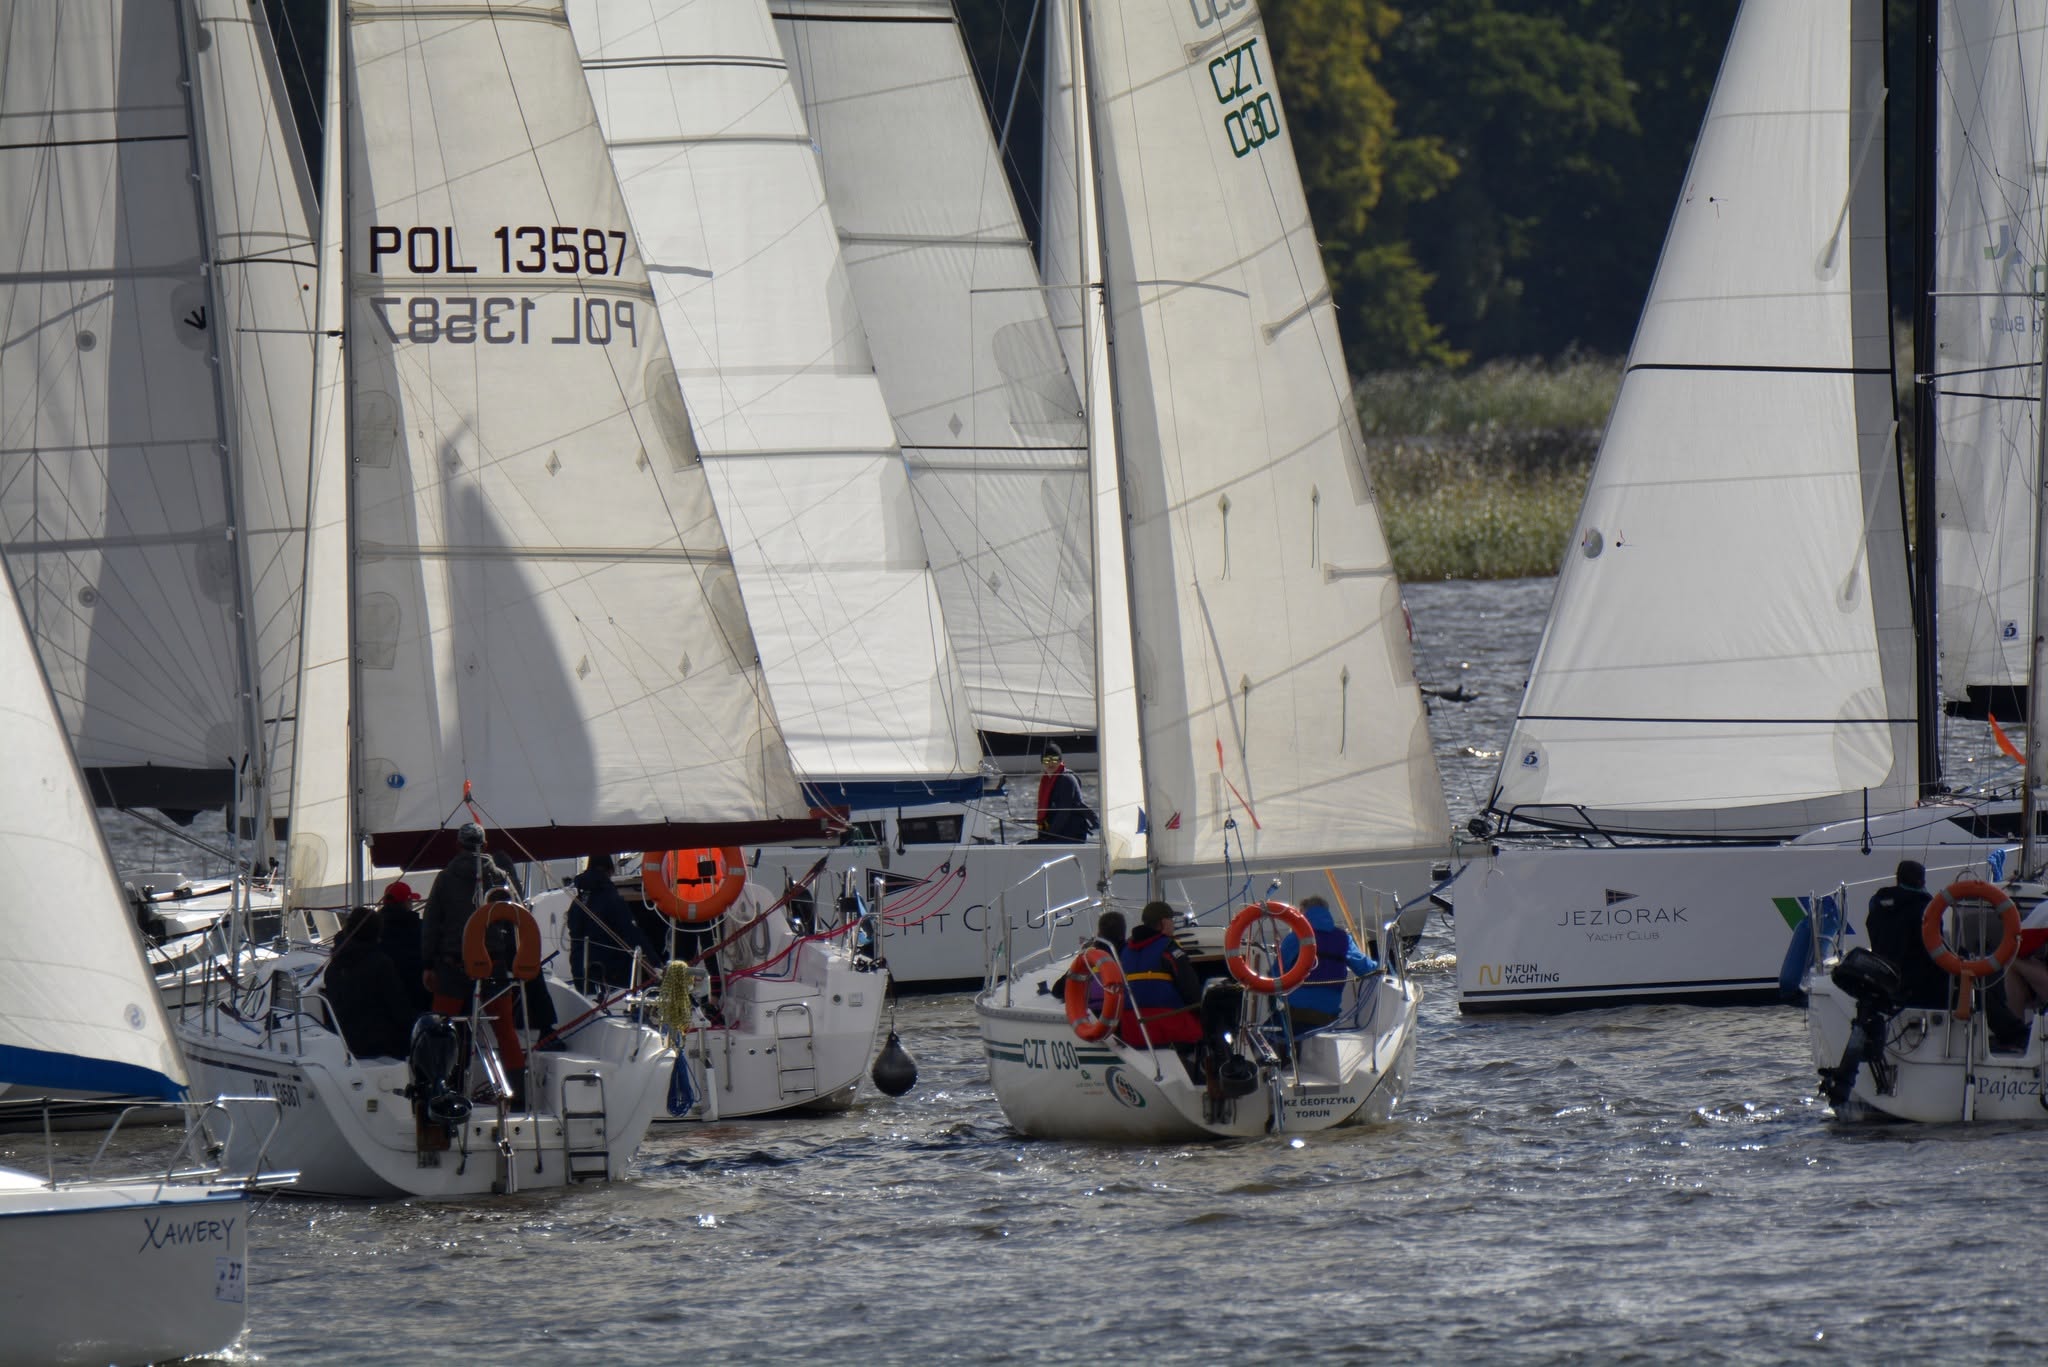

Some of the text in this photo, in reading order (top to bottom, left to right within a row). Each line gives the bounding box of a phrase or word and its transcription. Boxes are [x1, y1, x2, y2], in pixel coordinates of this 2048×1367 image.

[1208, 37, 1263, 105] CZT
[1224, 91, 1281, 159] 030
[370, 226, 627, 276] POL 13587
[820, 913, 950, 941] YHT
[1557, 907, 1689, 927] JEZIORAK
[1505, 972, 1560, 985] YACHTING
[1023, 1038, 1080, 1070] CZT 030
[1300, 1096, 1356, 1107] GEOFIZYKA
[1977, 1075, 2048, 1102] Pającz
[138, 1216, 236, 1255] XAWERY
